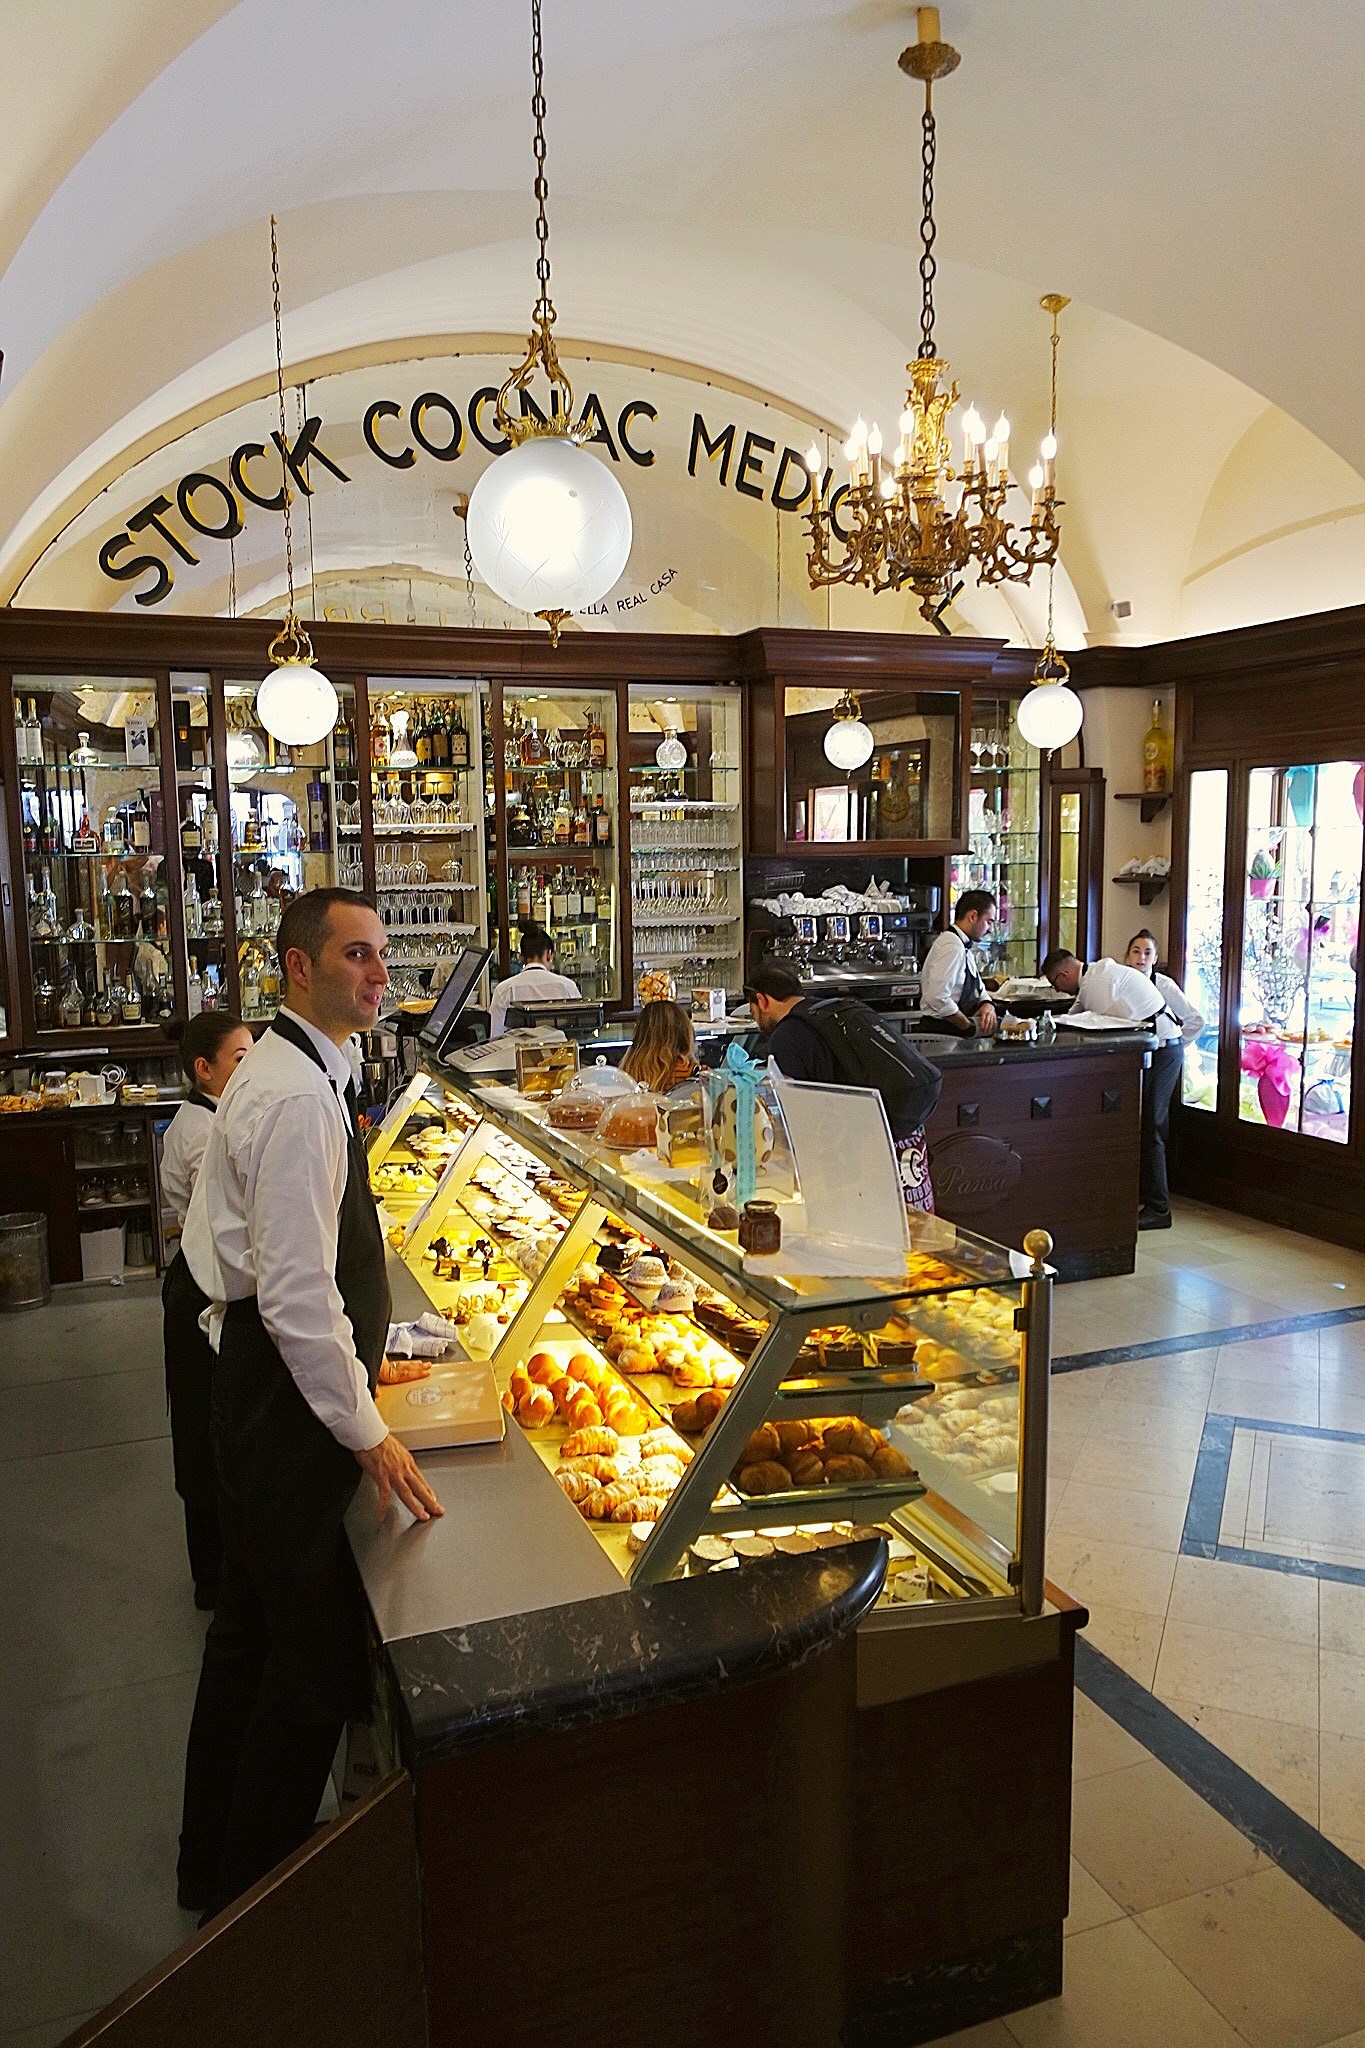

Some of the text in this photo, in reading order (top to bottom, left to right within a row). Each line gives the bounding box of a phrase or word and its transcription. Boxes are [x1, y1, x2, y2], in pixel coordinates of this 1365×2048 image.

[99, 415, 351, 606] STOCK
[362, 386, 658, 469] COGNAC
[616, 592, 648, 612] REAL
[650, 568, 678, 595] CASA
